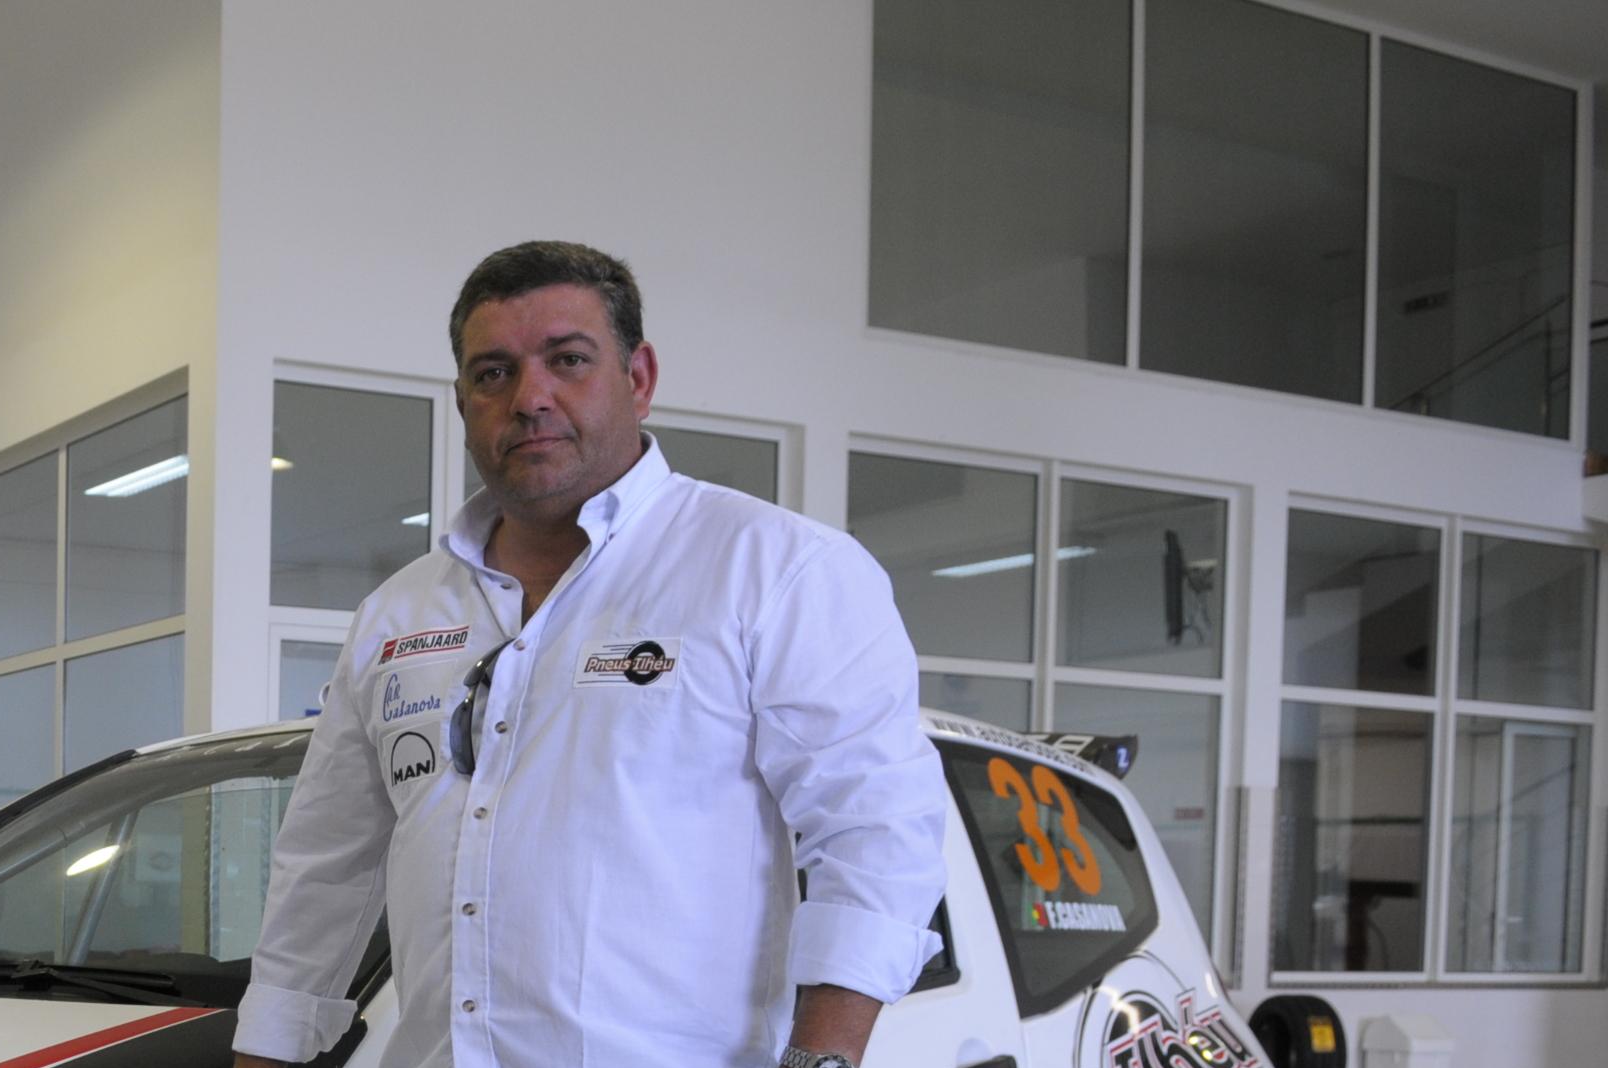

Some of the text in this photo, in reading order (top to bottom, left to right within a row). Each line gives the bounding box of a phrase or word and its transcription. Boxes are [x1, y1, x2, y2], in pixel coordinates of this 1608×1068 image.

[396, 631, 468, 654] SPANJAARD
[584, 657, 631, 672] Pneus
[393, 760, 431, 785] MAN
[988, 757, 1102, 896] 33
